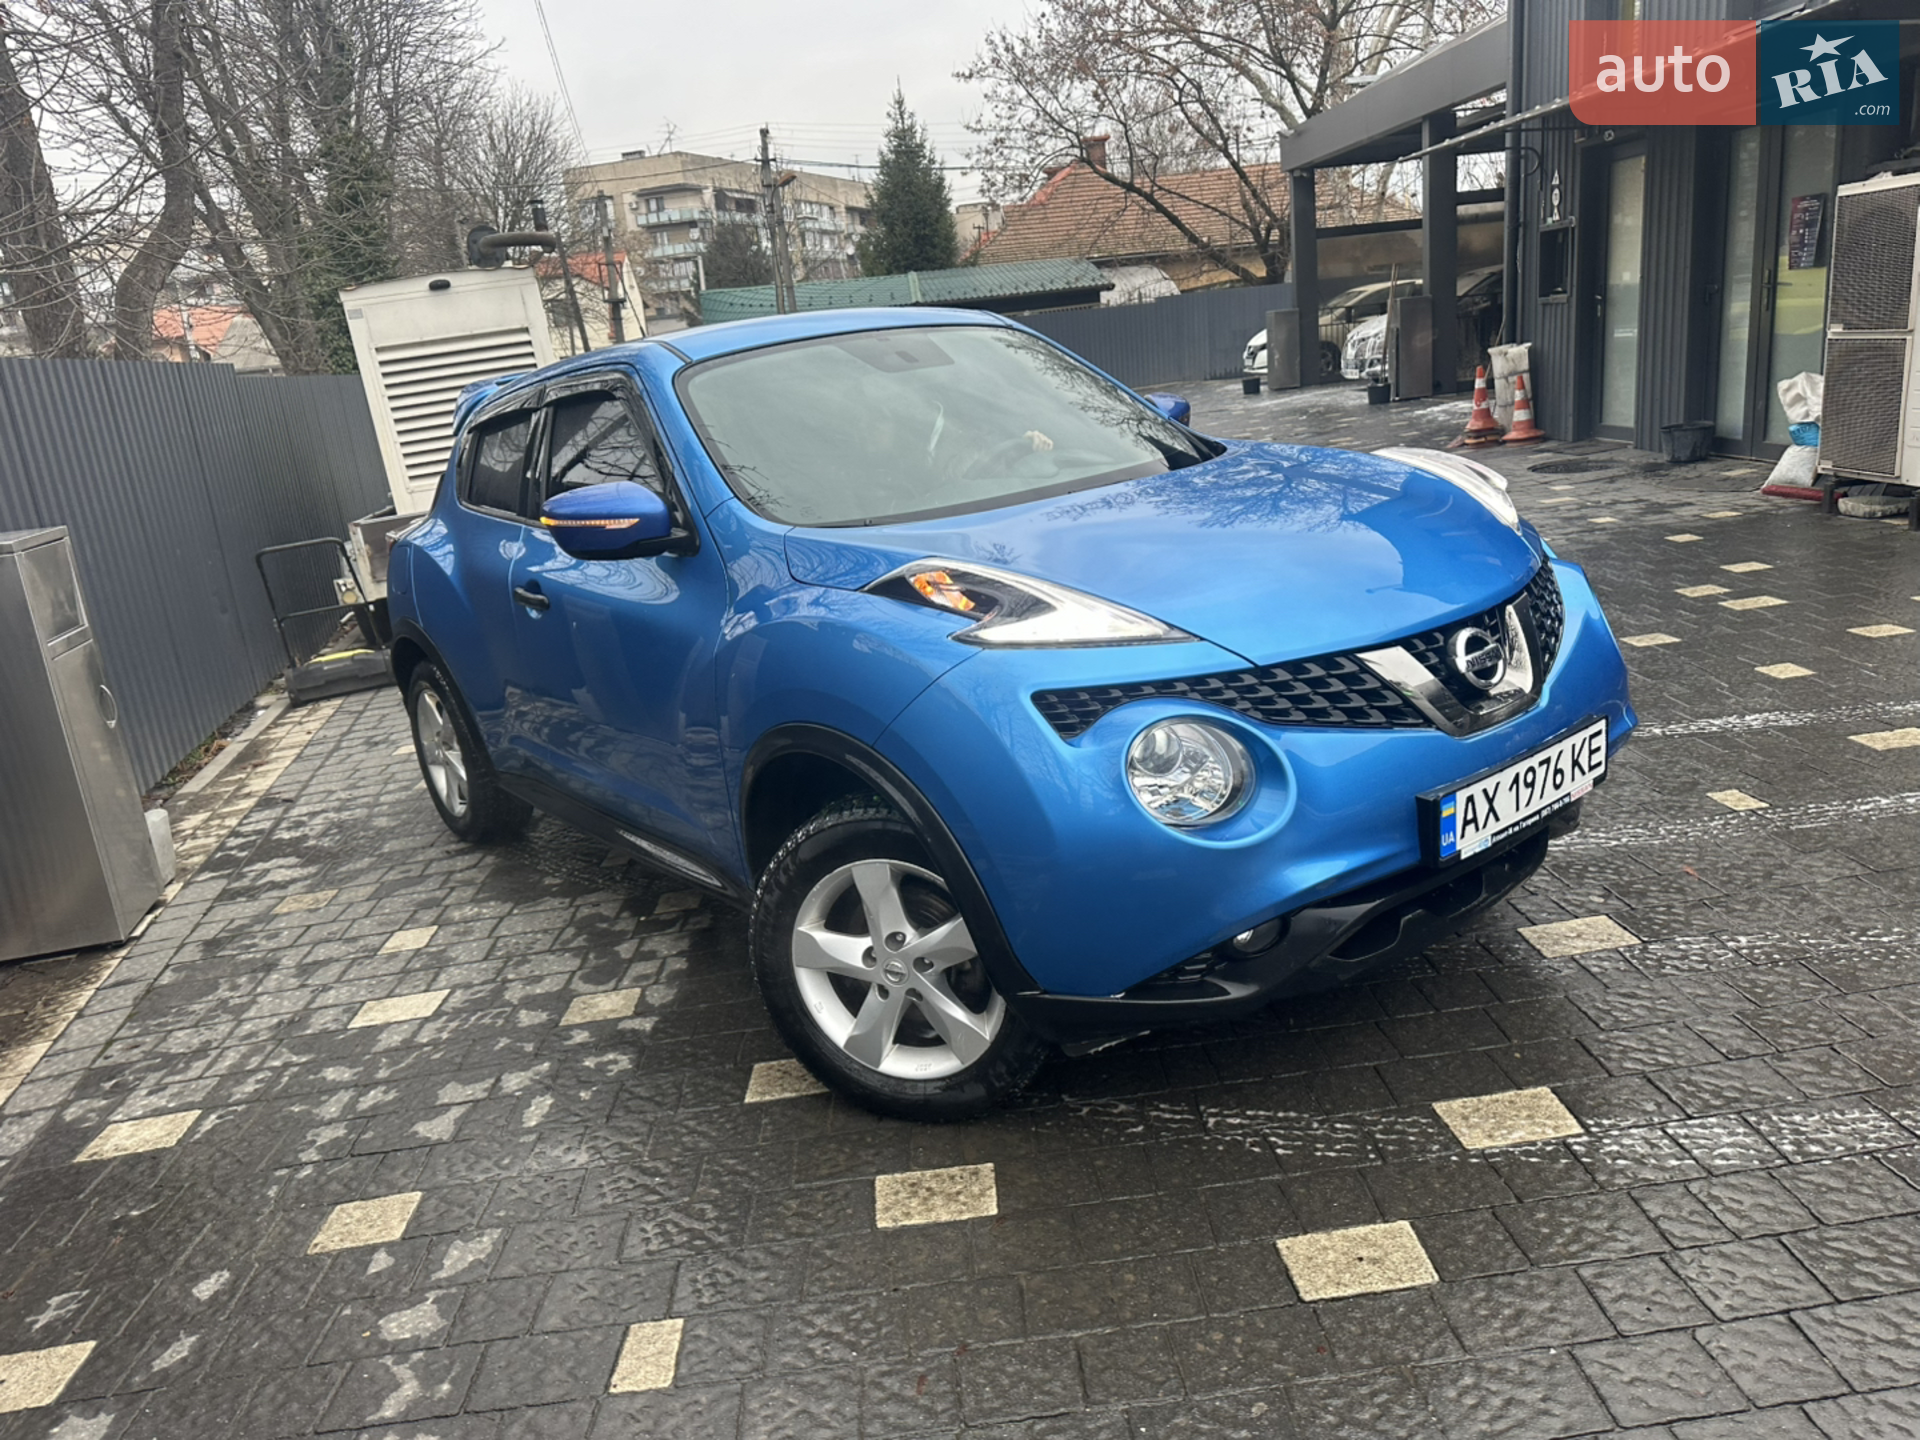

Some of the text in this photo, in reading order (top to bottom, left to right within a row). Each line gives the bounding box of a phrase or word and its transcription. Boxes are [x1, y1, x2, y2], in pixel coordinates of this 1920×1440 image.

[1460, 728, 1603, 840] AX 1976 KE
[1441, 830, 1456, 847] UA
